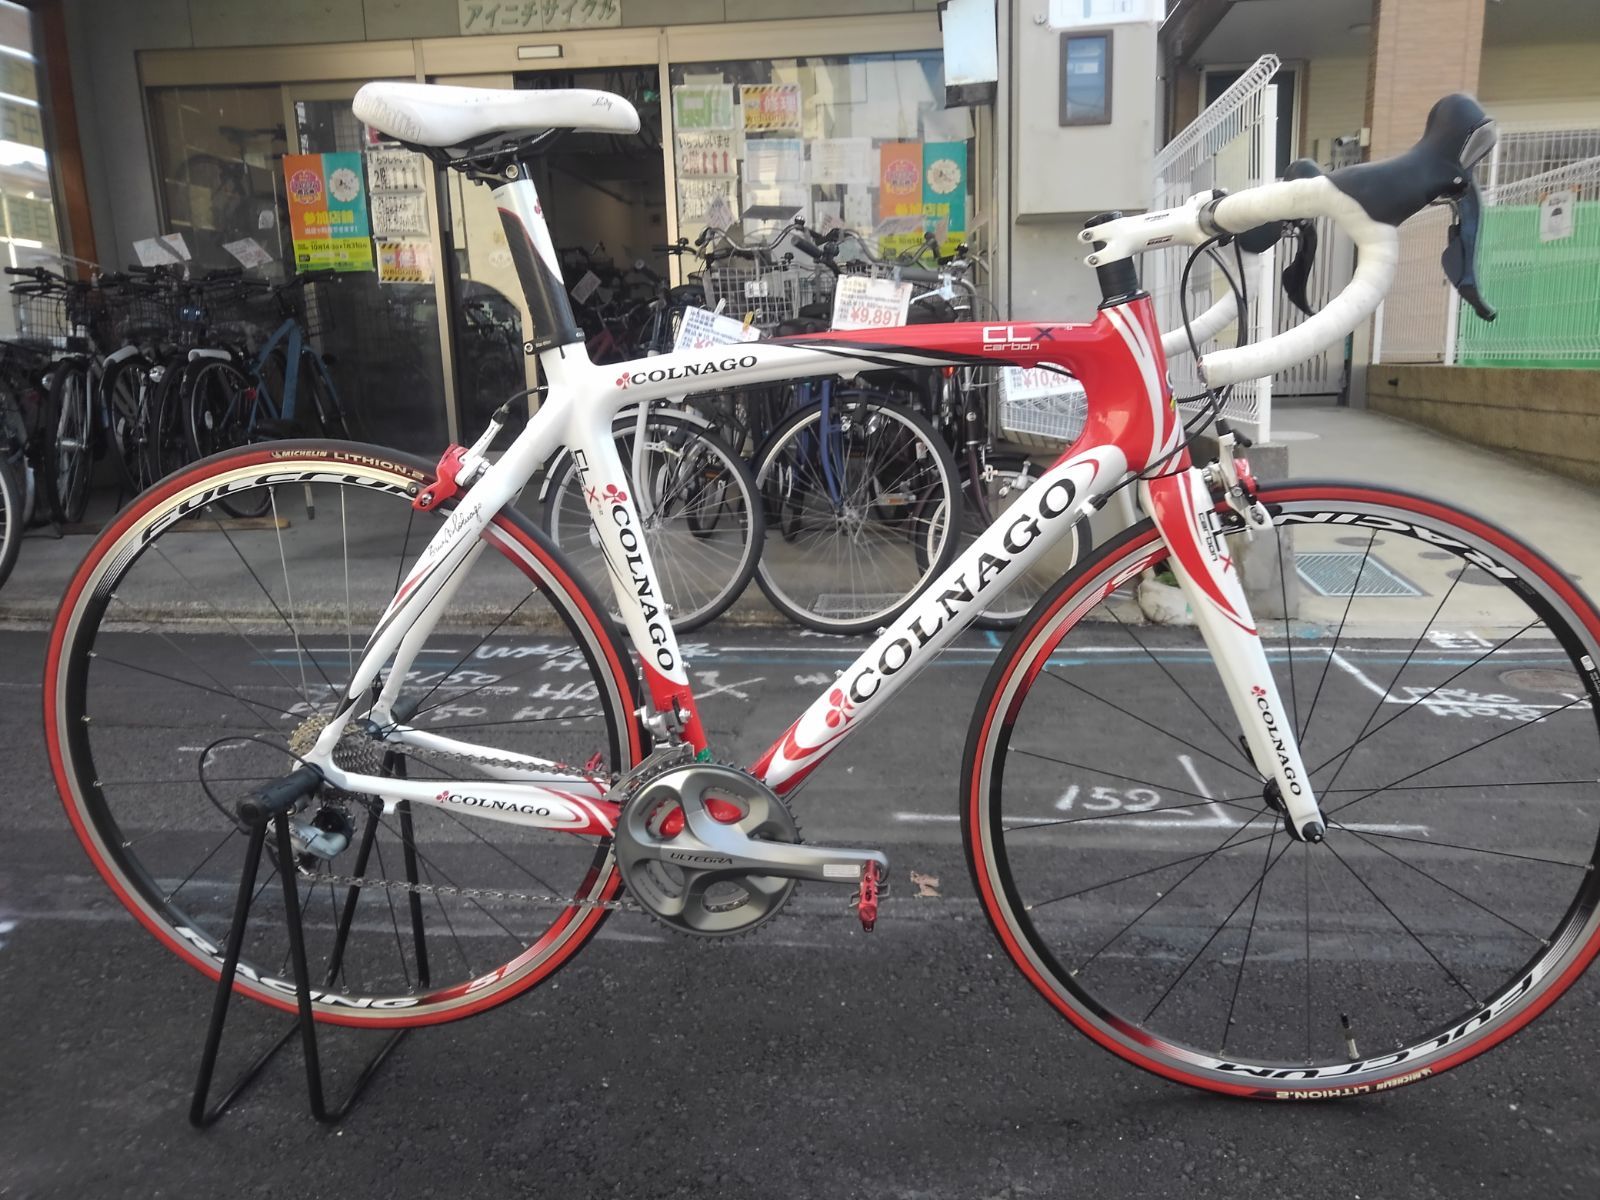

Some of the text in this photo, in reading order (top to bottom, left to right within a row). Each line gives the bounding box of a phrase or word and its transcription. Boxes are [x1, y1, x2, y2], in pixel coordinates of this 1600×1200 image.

[851, 306, 901, 327] ¥9,891
[983, 343, 1040, 351] carbon
[631, 355, 757, 385] COLNAGO
[282, 450, 425, 481] MICHELIN LITHION.2
[1198, 512, 1218, 562] carbon
[612, 504, 674, 672] COLNAGO
[849, 478, 1076, 704] COLNAGO
[1257, 697, 1302, 796] COLNAGO
[449, 794, 551, 817] COLNAGO
[670, 852, 733, 865] ULTEGRA
[1215, 973, 1533, 1079] FULCRUM
[1276, 1071, 1423, 1099] MICHELIN LITHION.2
